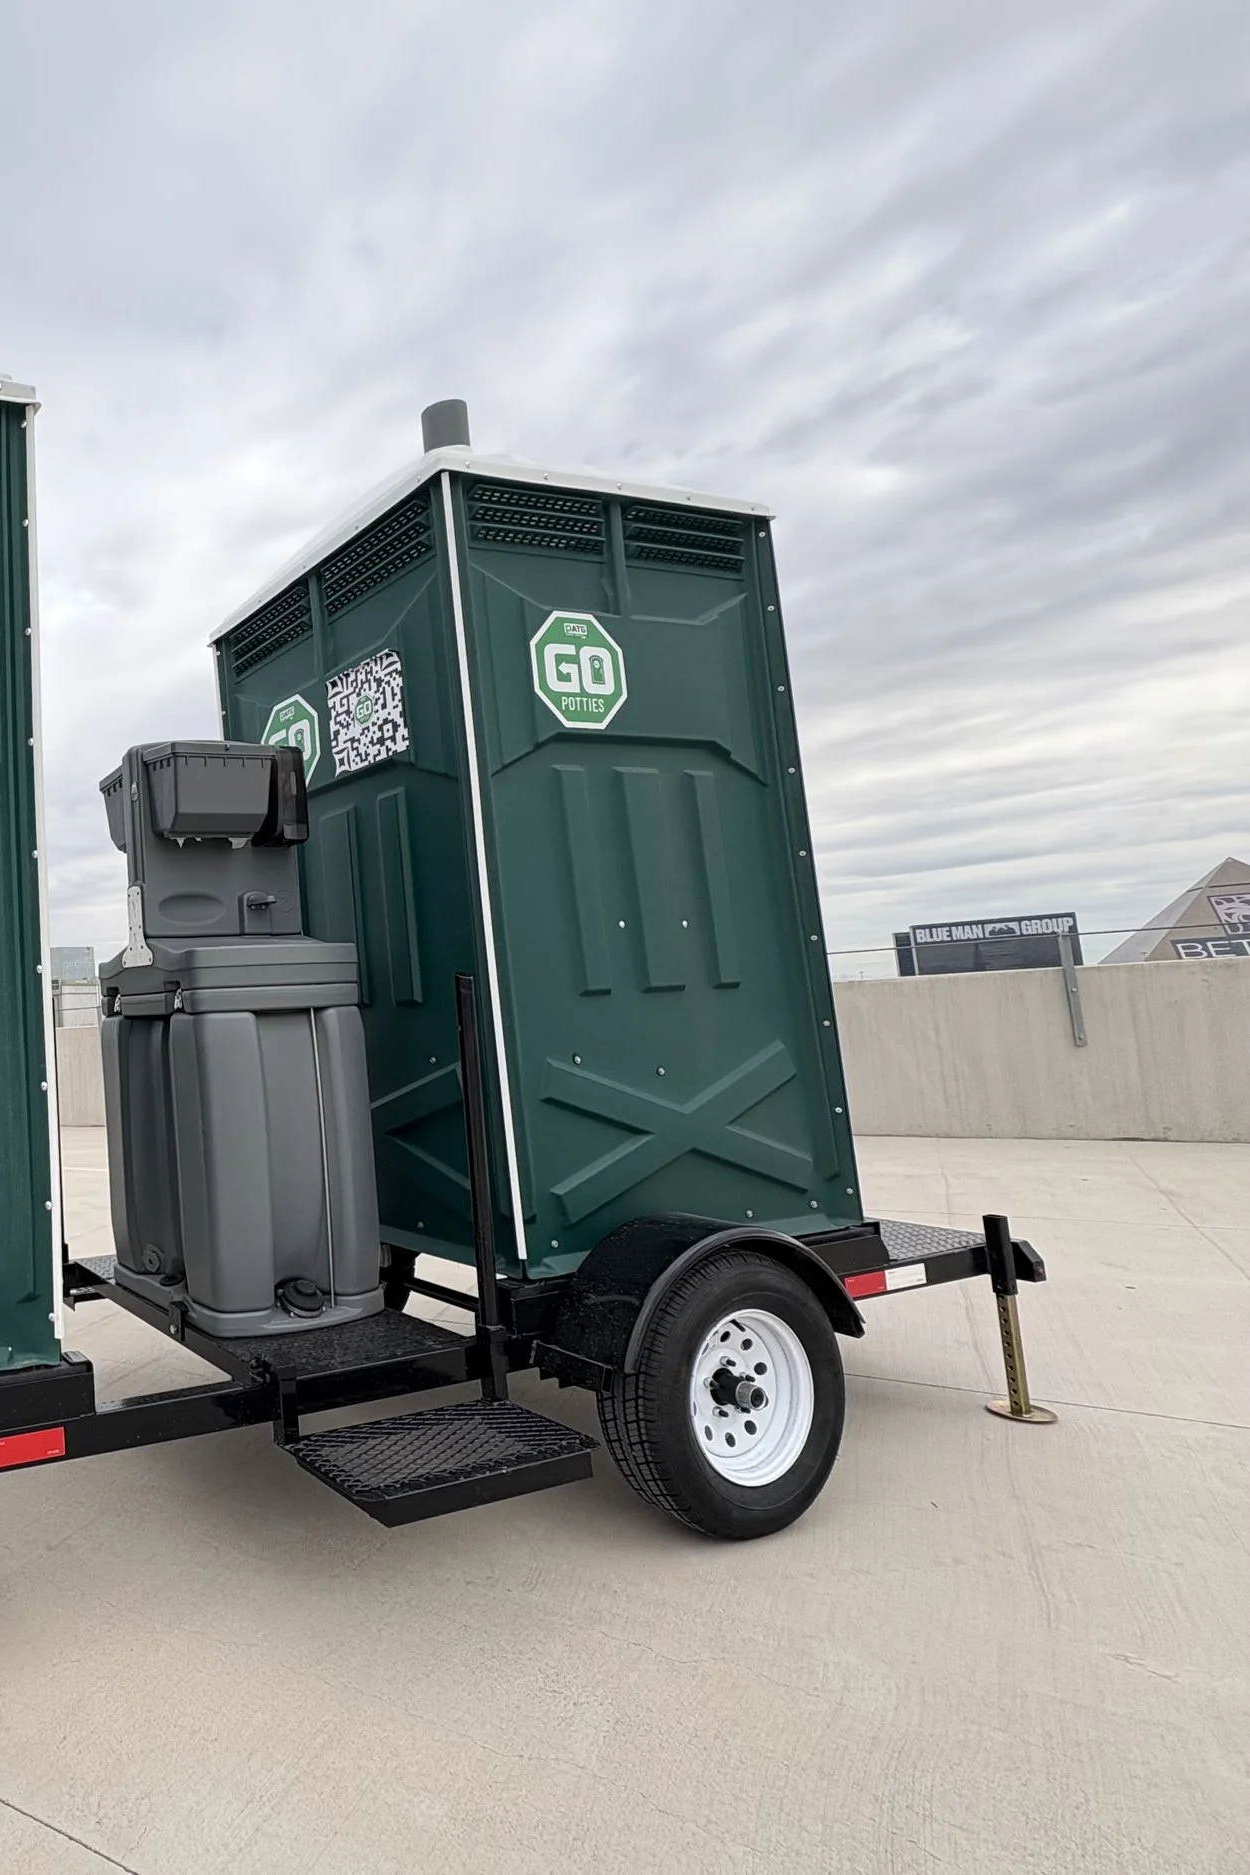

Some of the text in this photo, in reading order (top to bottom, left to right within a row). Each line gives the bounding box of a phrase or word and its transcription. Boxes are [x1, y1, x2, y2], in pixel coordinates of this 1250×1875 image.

[544, 643, 616, 696] GO
[356, 700, 372, 719] GO
[561, 696, 606, 713] POTTIES
[915, 917, 1074, 943] BLUE MAN GROUP
